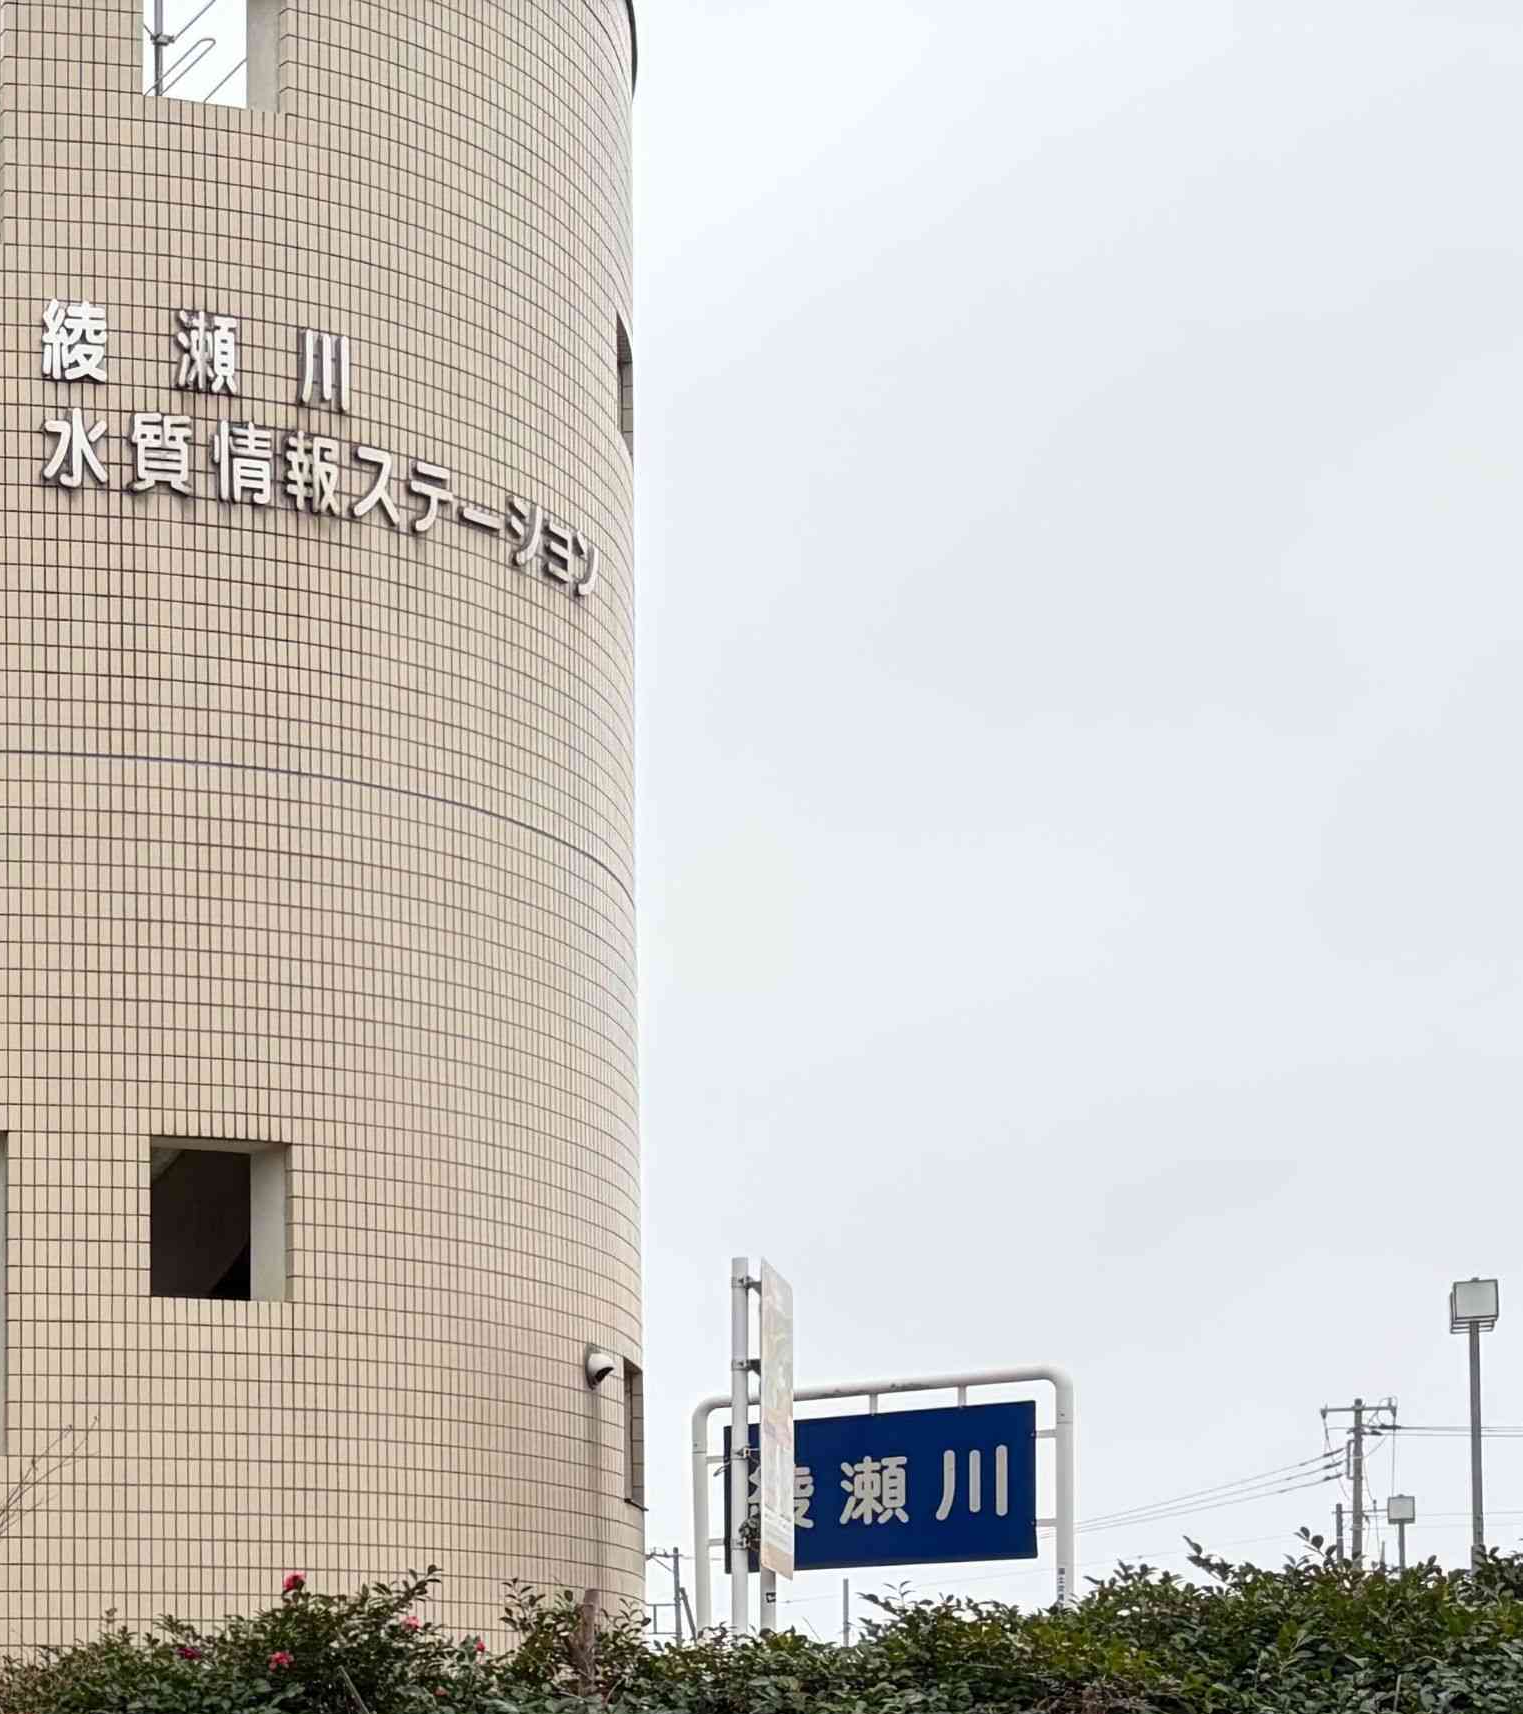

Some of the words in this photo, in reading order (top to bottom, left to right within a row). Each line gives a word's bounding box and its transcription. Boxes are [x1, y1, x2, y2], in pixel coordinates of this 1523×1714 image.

[41, 299, 351, 411] 綾瀬川
[42, 407, 599, 597] 水質情報ステーション
